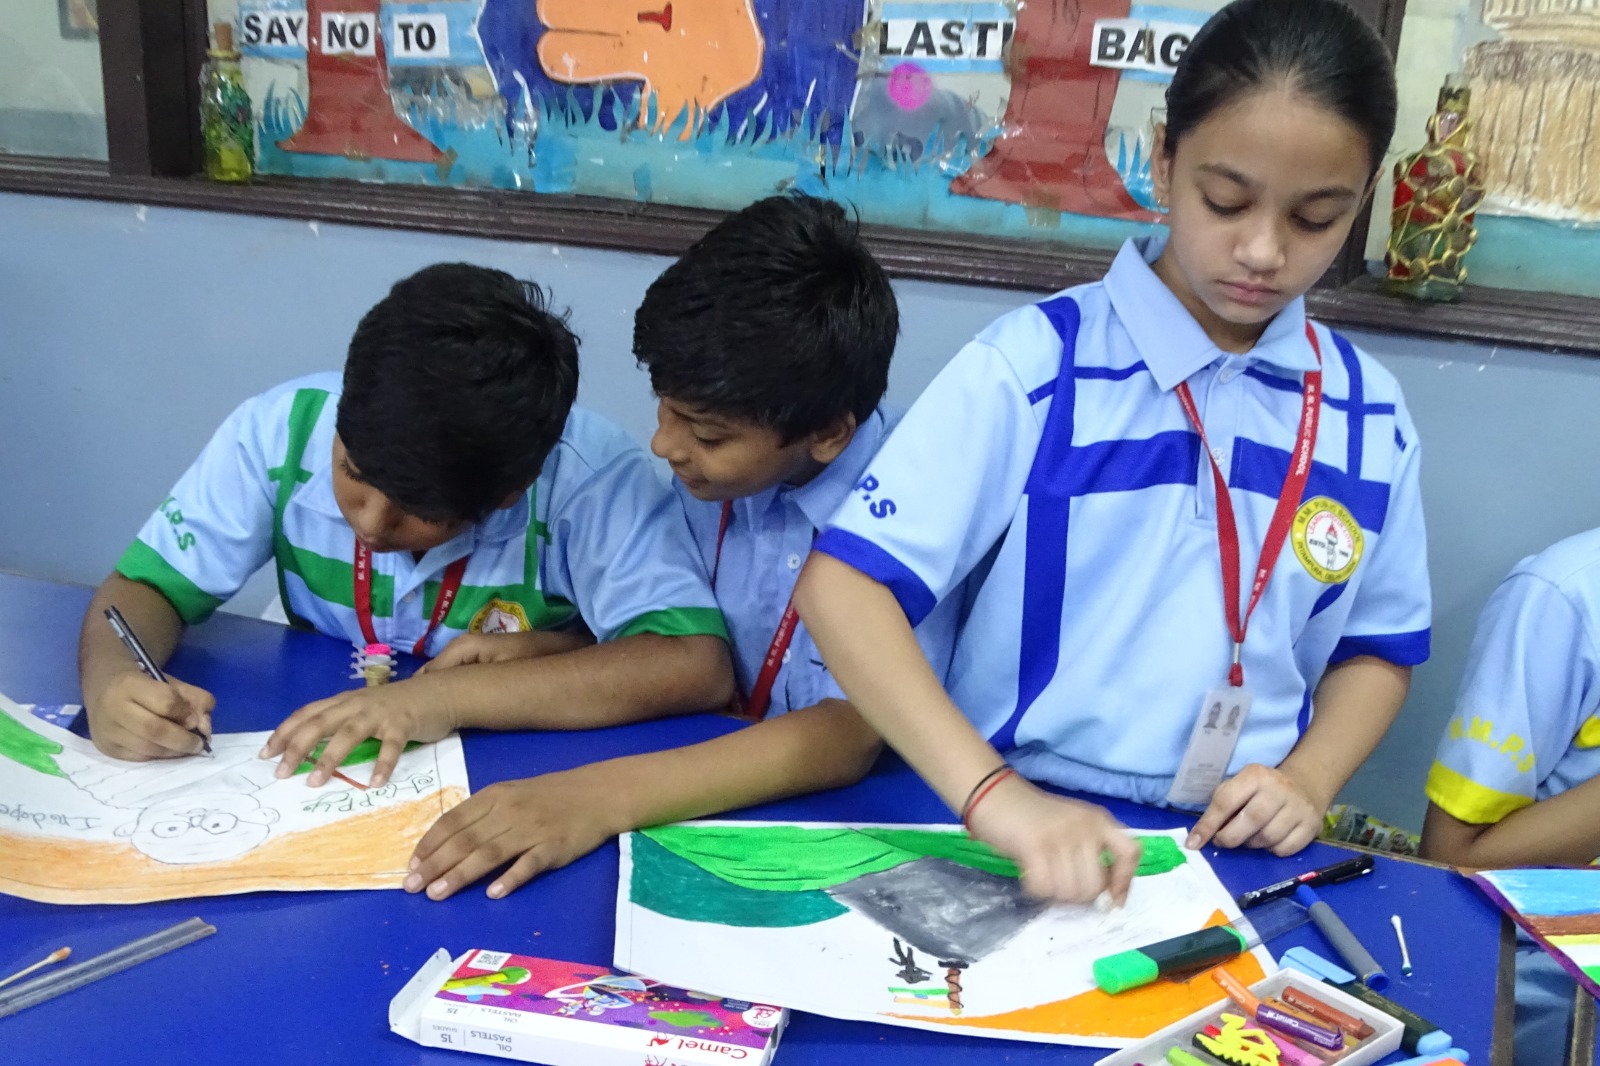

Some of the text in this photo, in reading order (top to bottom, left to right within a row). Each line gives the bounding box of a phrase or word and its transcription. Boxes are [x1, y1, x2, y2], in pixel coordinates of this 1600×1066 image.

[244, 14, 303, 44] SAY
[327, 19, 369, 48] NO
[398, 22, 436, 51] TO
[1295, 439, 1310, 476] SCHOOL
[1337, 509, 1361, 543] SCHOOL
[440, 1033, 453, 1044] 15
[470, 1030, 512, 1043] PASTELS
[496, 1043, 512, 1053] OIL
[678, 1039, 748, 1060] Camel
